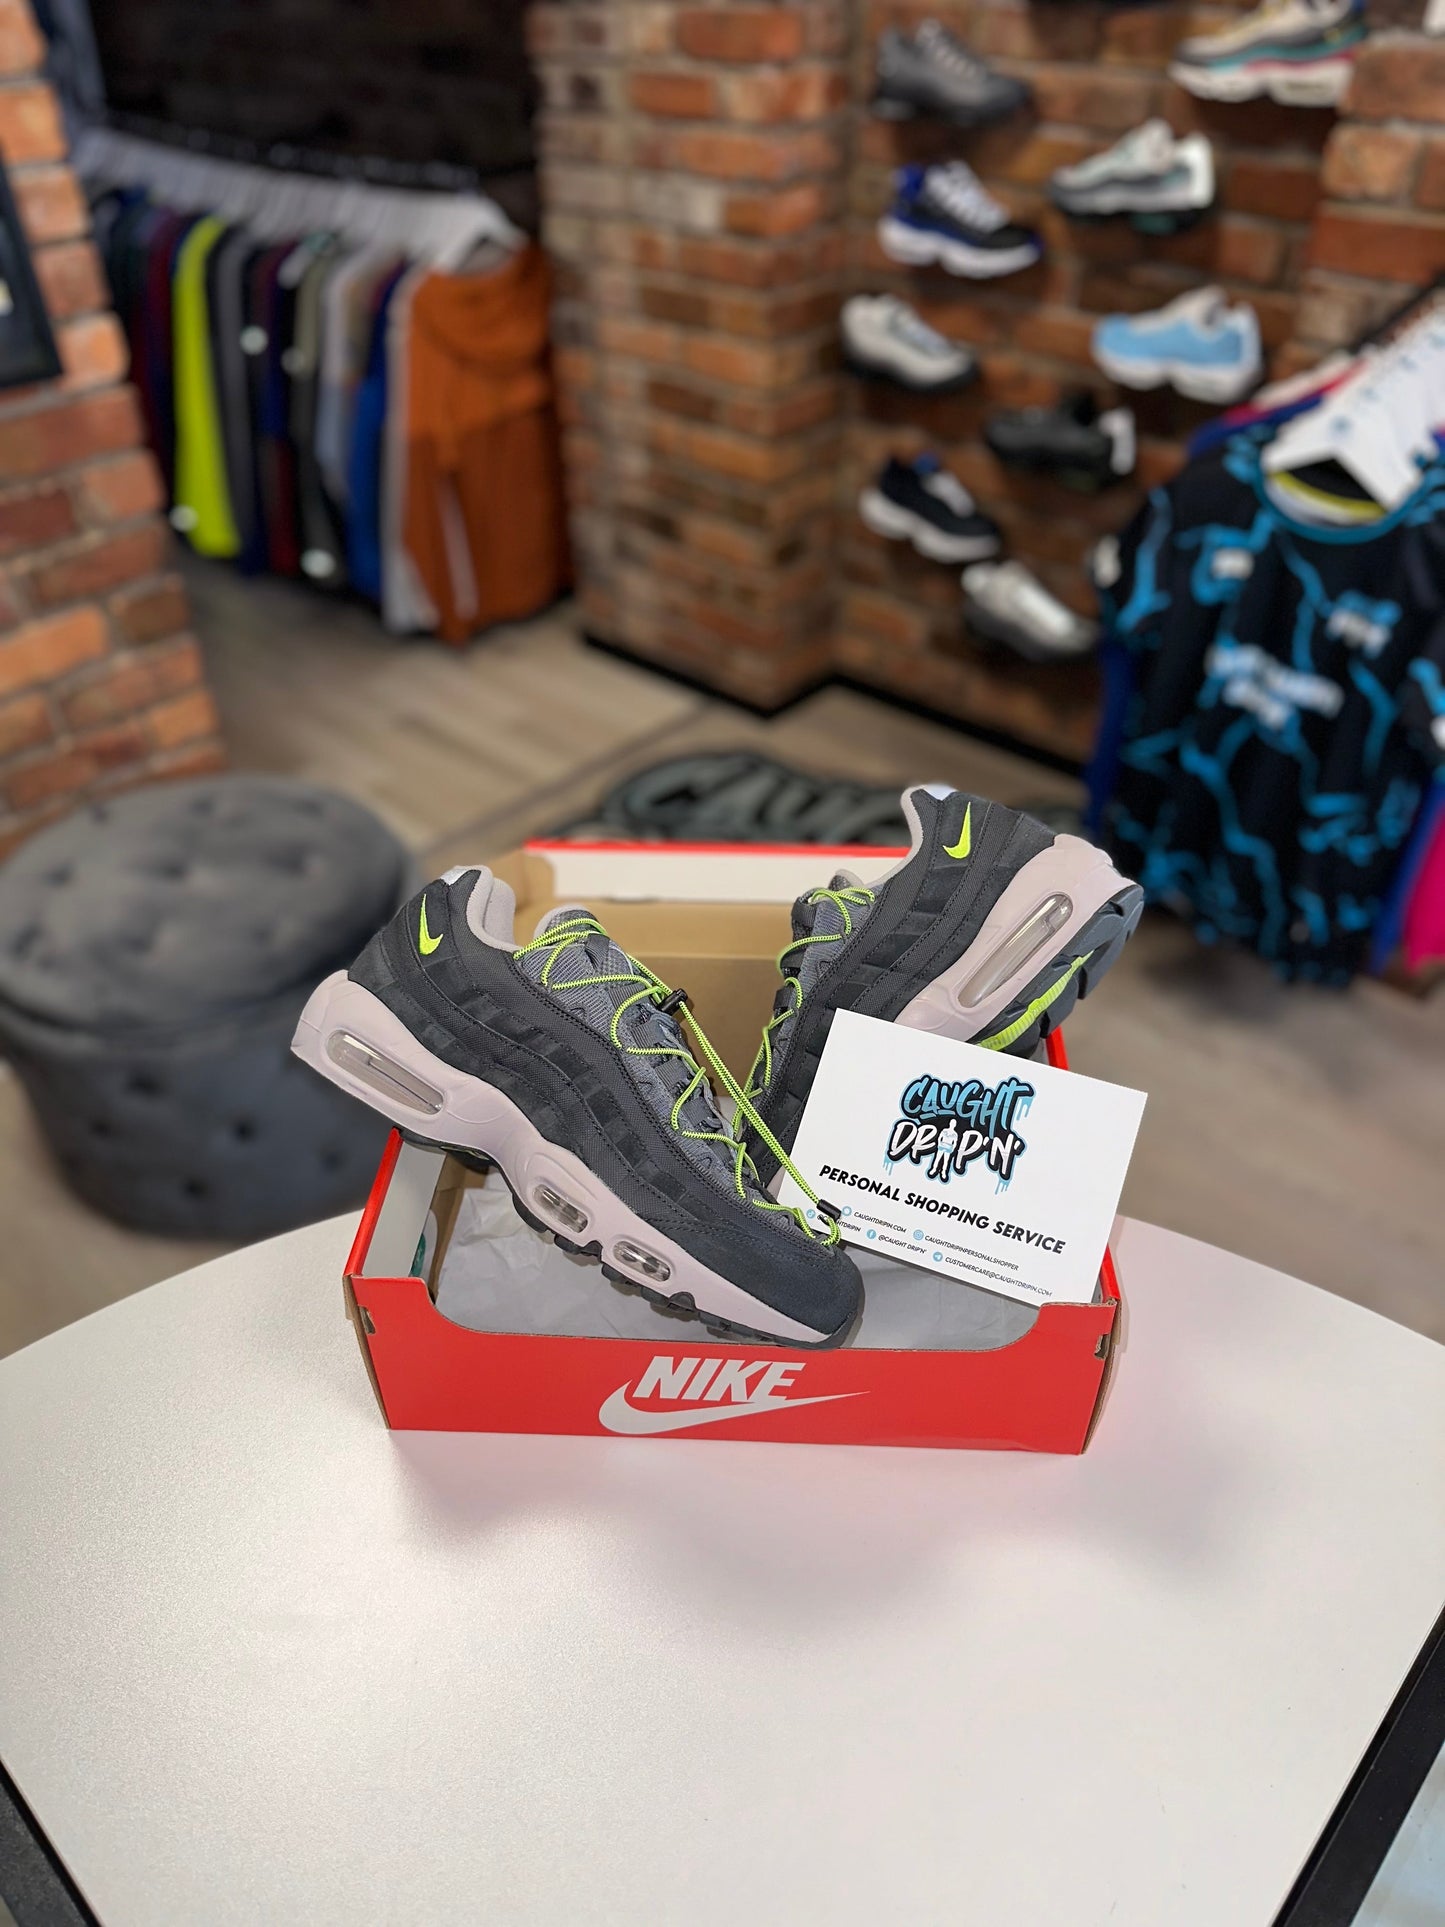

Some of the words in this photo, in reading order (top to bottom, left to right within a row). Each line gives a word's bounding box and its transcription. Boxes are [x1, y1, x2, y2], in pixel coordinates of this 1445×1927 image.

[902, 1076, 1031, 1138] CAUGHT
[819, 1164, 901, 1201] PERSONAL
[904, 1192, 990, 1229] SHOPPING
[992, 1221, 1066, 1254] SERVICE
[853, 1211, 907, 1233] CAUGHTDRIPIN.COM
[878, 1234, 907, 1248] @CAUGHT
[924, 1235, 1020, 1271] CAUGHTDRIPINPERSONALSHOPPER
[945, 1257, 1053, 1297] CUSTOMERCARE@CAUGHTDRIPIN.COM
[632, 1355, 806, 1402] NIKE
